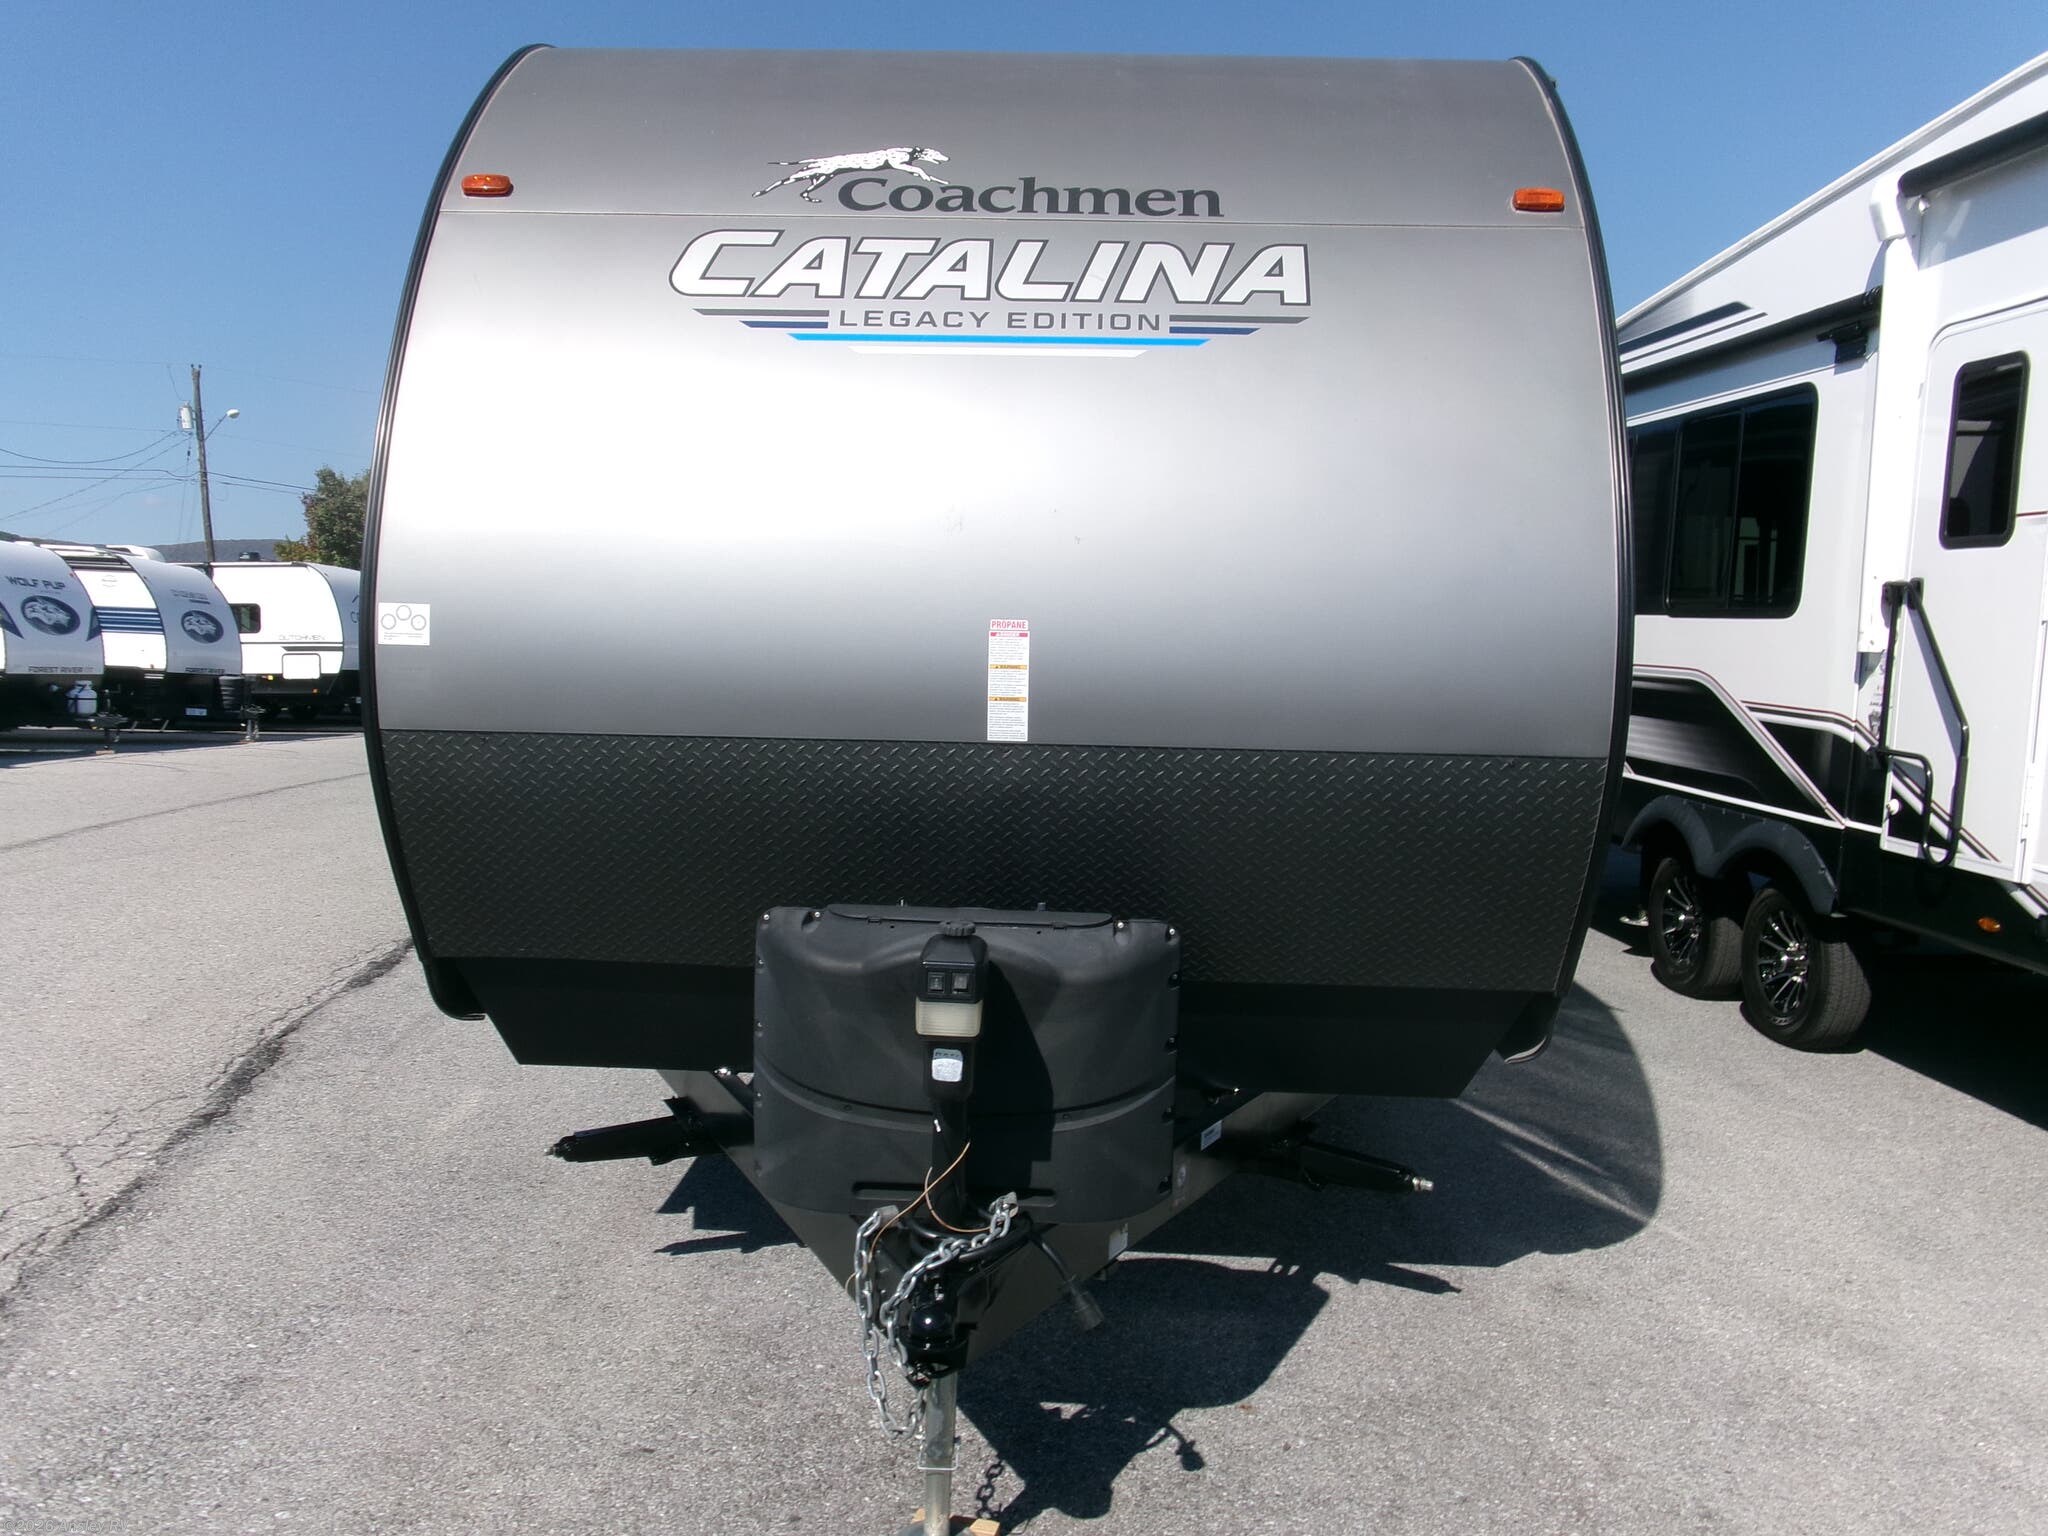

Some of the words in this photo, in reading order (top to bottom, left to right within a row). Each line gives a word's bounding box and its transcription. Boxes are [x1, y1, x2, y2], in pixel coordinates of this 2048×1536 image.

[838, 176, 1224, 218] Coachmen
[668, 229, 1311, 306] CATALINA
[838, 309, 989, 330] LEGACY
[1006, 312, 1161, 332] EDITION
[5, 576, 38, 588] WOLF
[41, 579, 66, 590] PUP
[991, 620, 1027, 629] PROPANE
[28, 665, 58, 673] FOREST
